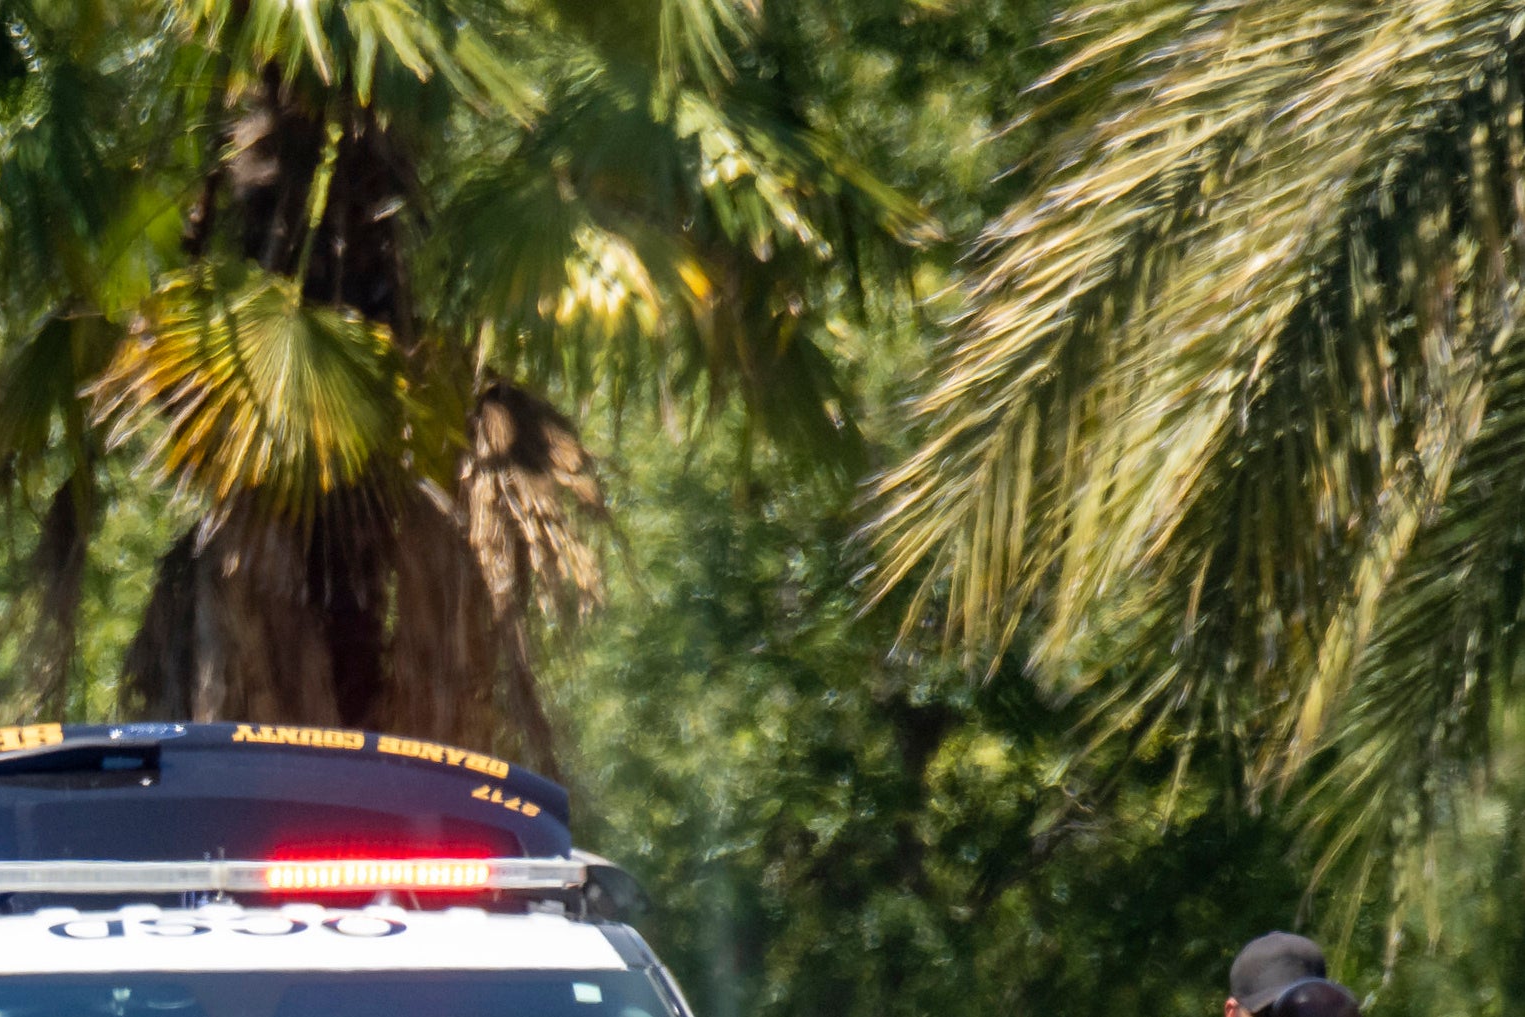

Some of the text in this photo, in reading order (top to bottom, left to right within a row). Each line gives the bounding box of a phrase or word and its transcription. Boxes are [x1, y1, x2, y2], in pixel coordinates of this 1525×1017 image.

[232, 724, 509, 779] ORANGE COUNTY
[471, 784, 541, 818] 2717
[48, 914, 408, 940] OCSD
